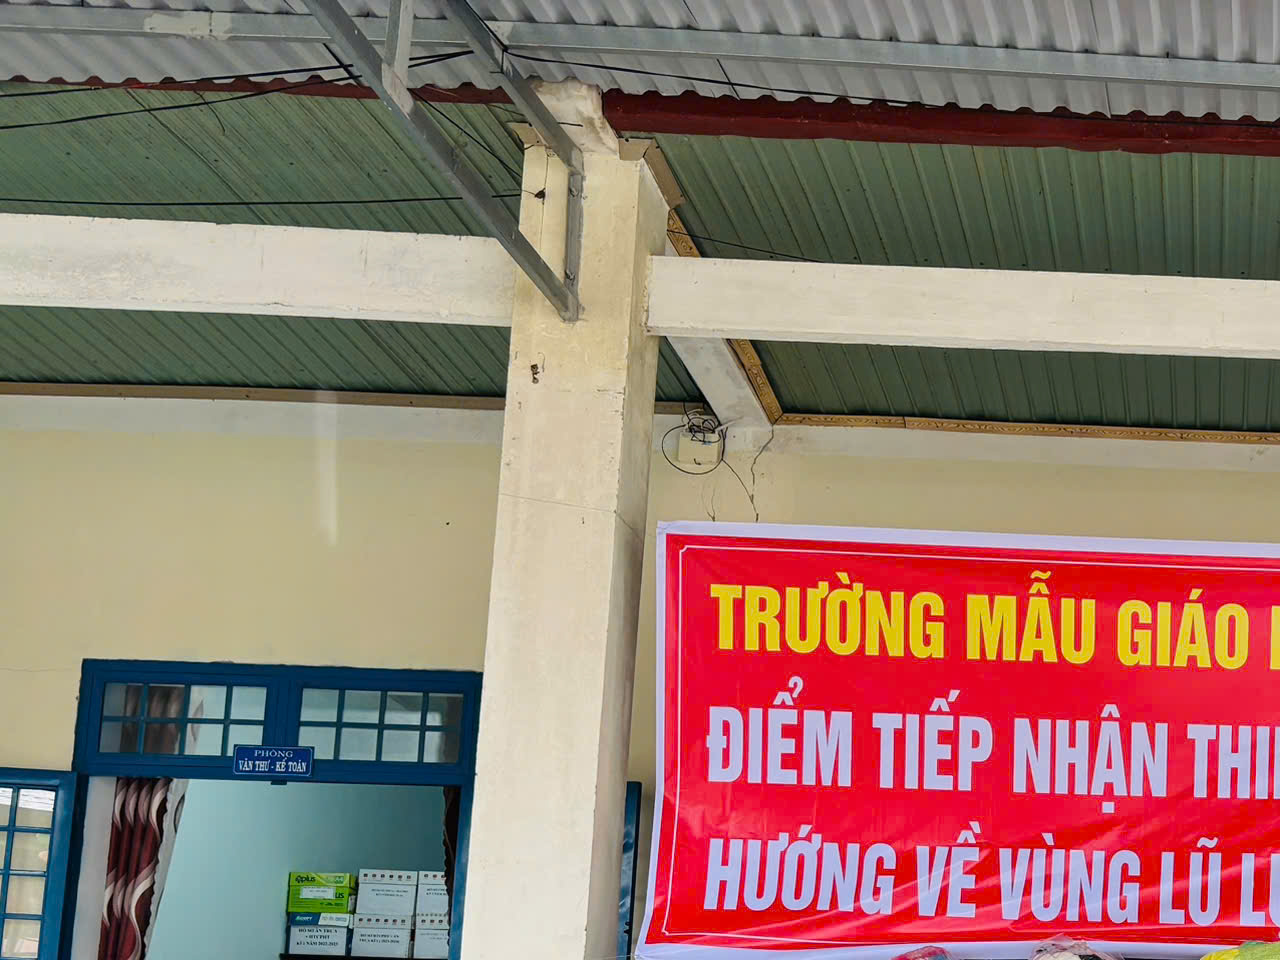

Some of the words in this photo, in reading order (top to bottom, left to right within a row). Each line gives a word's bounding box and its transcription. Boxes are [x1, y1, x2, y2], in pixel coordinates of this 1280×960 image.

[710, 572, 945, 659] TRƯỜNG
[967, 568, 1096, 665] MẪU
[1117, 587, 1250, 670] GIÁO
[239, 758, 253, 771] VĂN
[254, 760, 270, 772] THƯ
[276, 757, 288, 772] KẾ
[288, 760, 306, 772] TOÁN
[254, 749, 294, 758] PHÒNG
[706, 675, 853, 788] ĐIỂM
[872, 690, 993, 793] TIẾP
[1013, 703, 1169, 814] NHẬN
[703, 824, 898, 917] HƯỚNG
[916, 821, 982, 919] VỀ
[999, 832, 1141, 924] VÙNG
[1159, 837, 1222, 927] LŨ
